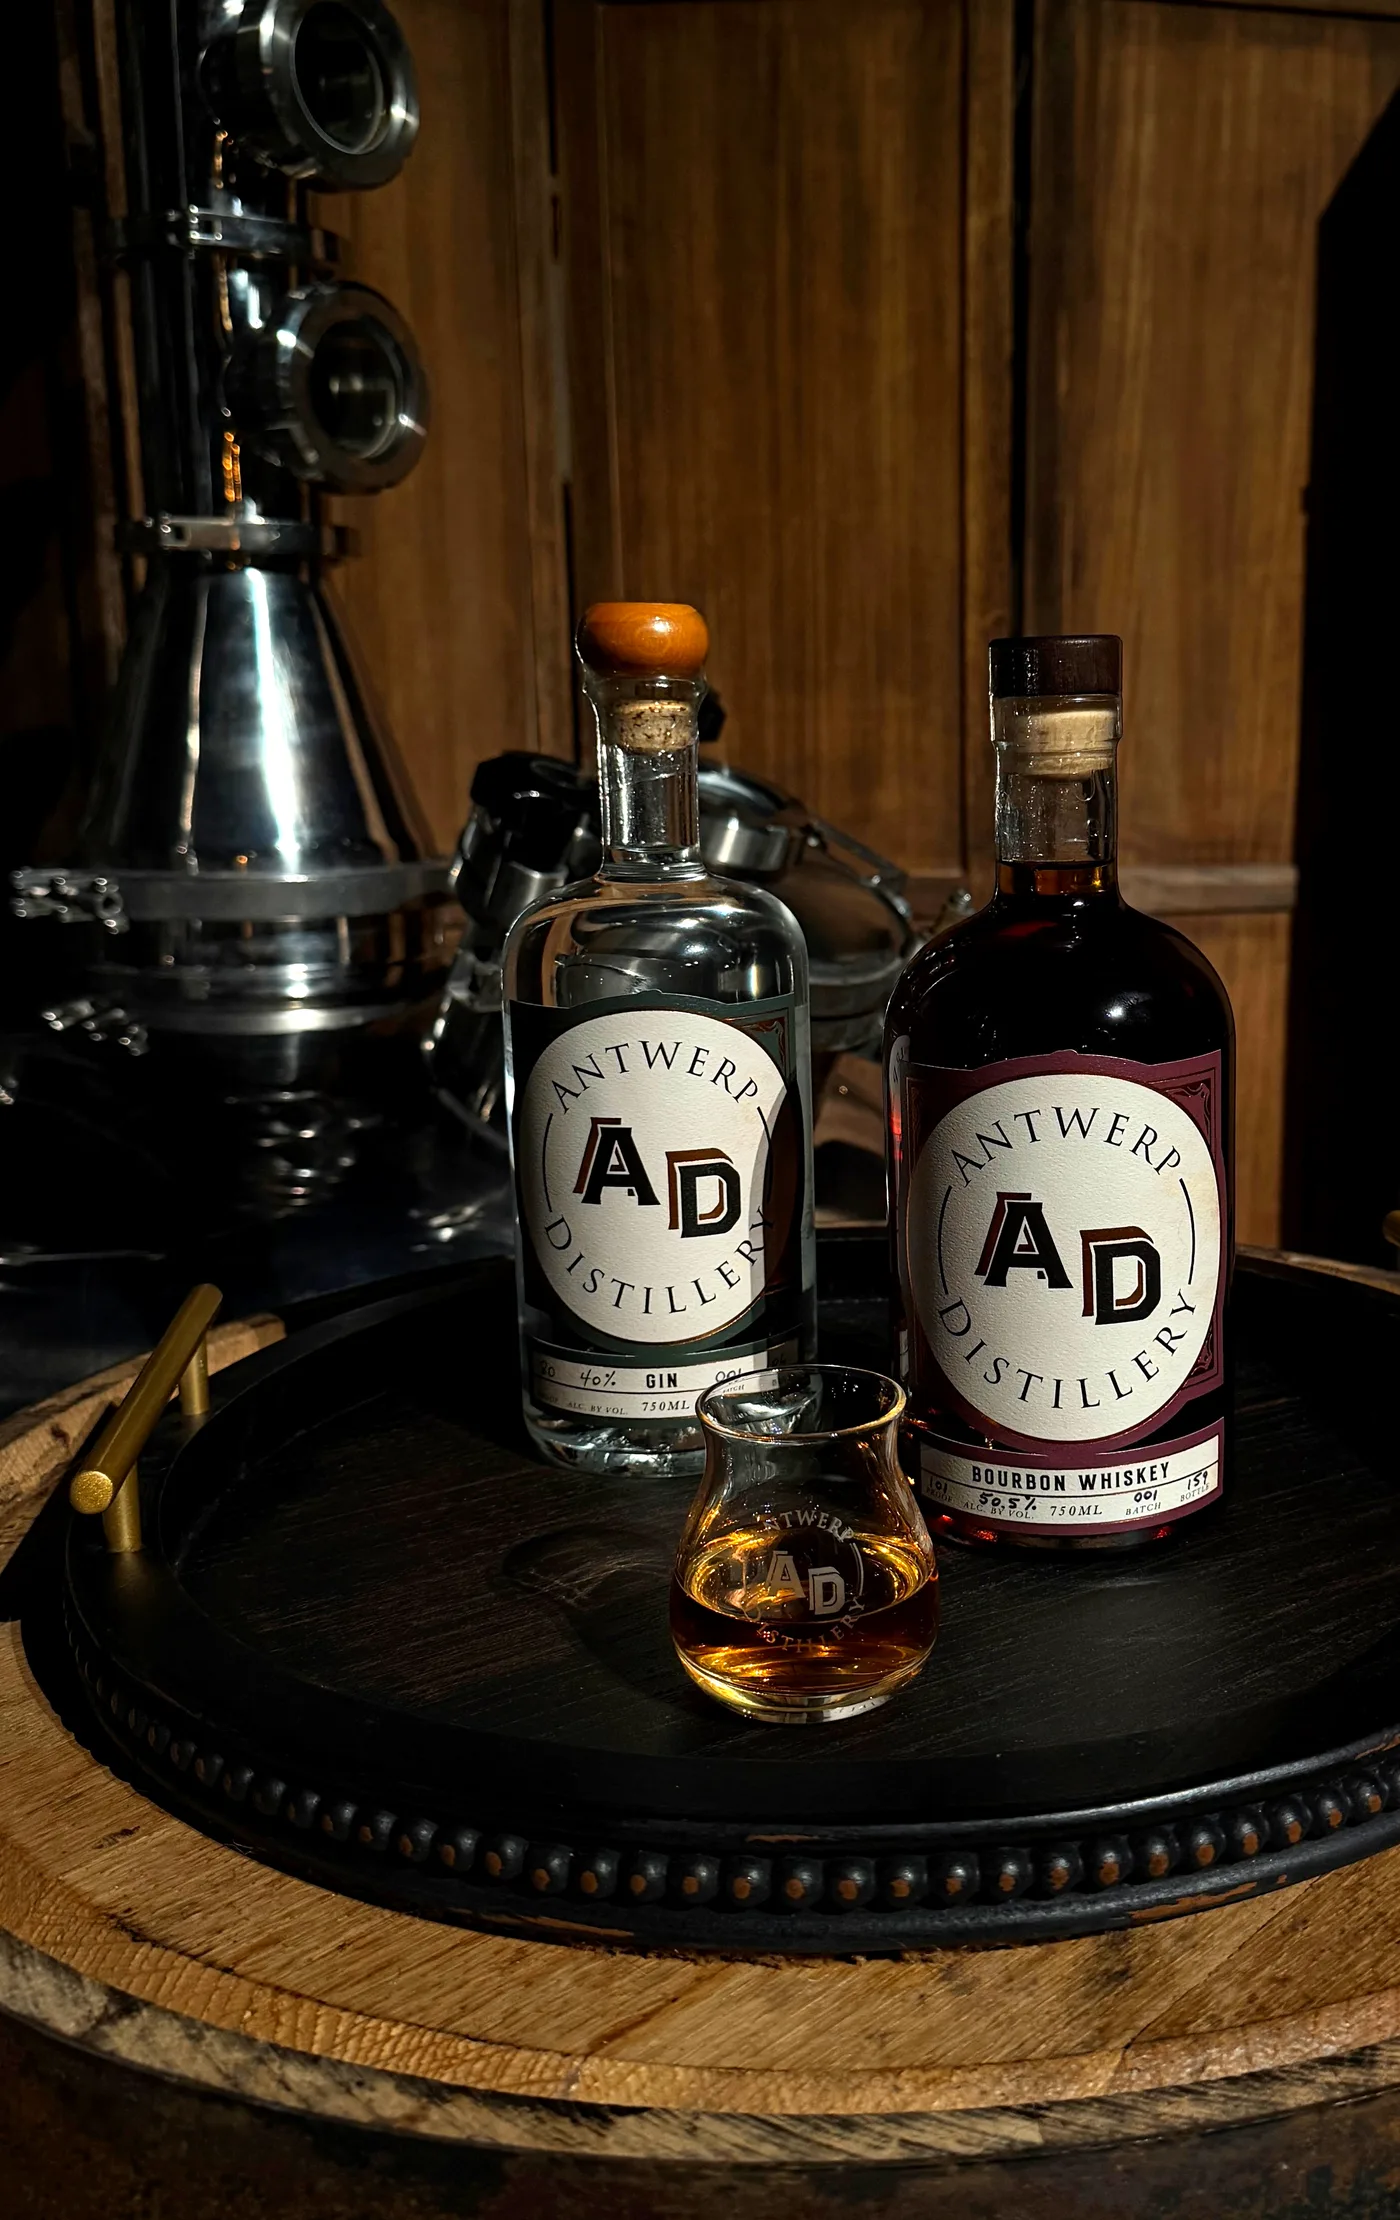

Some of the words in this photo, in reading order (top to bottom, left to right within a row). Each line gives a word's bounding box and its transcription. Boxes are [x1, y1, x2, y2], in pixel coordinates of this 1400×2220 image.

[551, 1040, 758, 1114] ANTWERP
[950, 1106, 1181, 1187] ANTWERP
[572, 1116, 742, 1238] AD
[544, 1205, 774, 1314] DISTILLERY
[973, 1191, 1161, 1325] AD
[938, 1289, 1197, 1409] DISTILLERY
[580, 1368, 616, 1387] 40%
[645, 1372, 678, 1389] GIN
[590, 1404, 602, 1412] BY
[606, 1406, 629, 1416] VOL.
[641, 1400, 690, 1412] 750ML
[929, 1475, 948, 1494] 101
[972, 1465, 1066, 1491] BOURBON
[1078, 1461, 1169, 1491] WHISKEY
[1187, 1470, 1209, 1490] 159
[1133, 1489, 1158, 1503] 001
[1180, 1483, 1211, 1502] BOTTLE
[963, 1501, 986, 1513] ALC.
[1009, 1509, 1035, 1520] VOL.
[1050, 1505, 1103, 1517] 750ML
[1125, 1502, 1162, 1516] BATCH
[765, 1551, 846, 1615] AD
